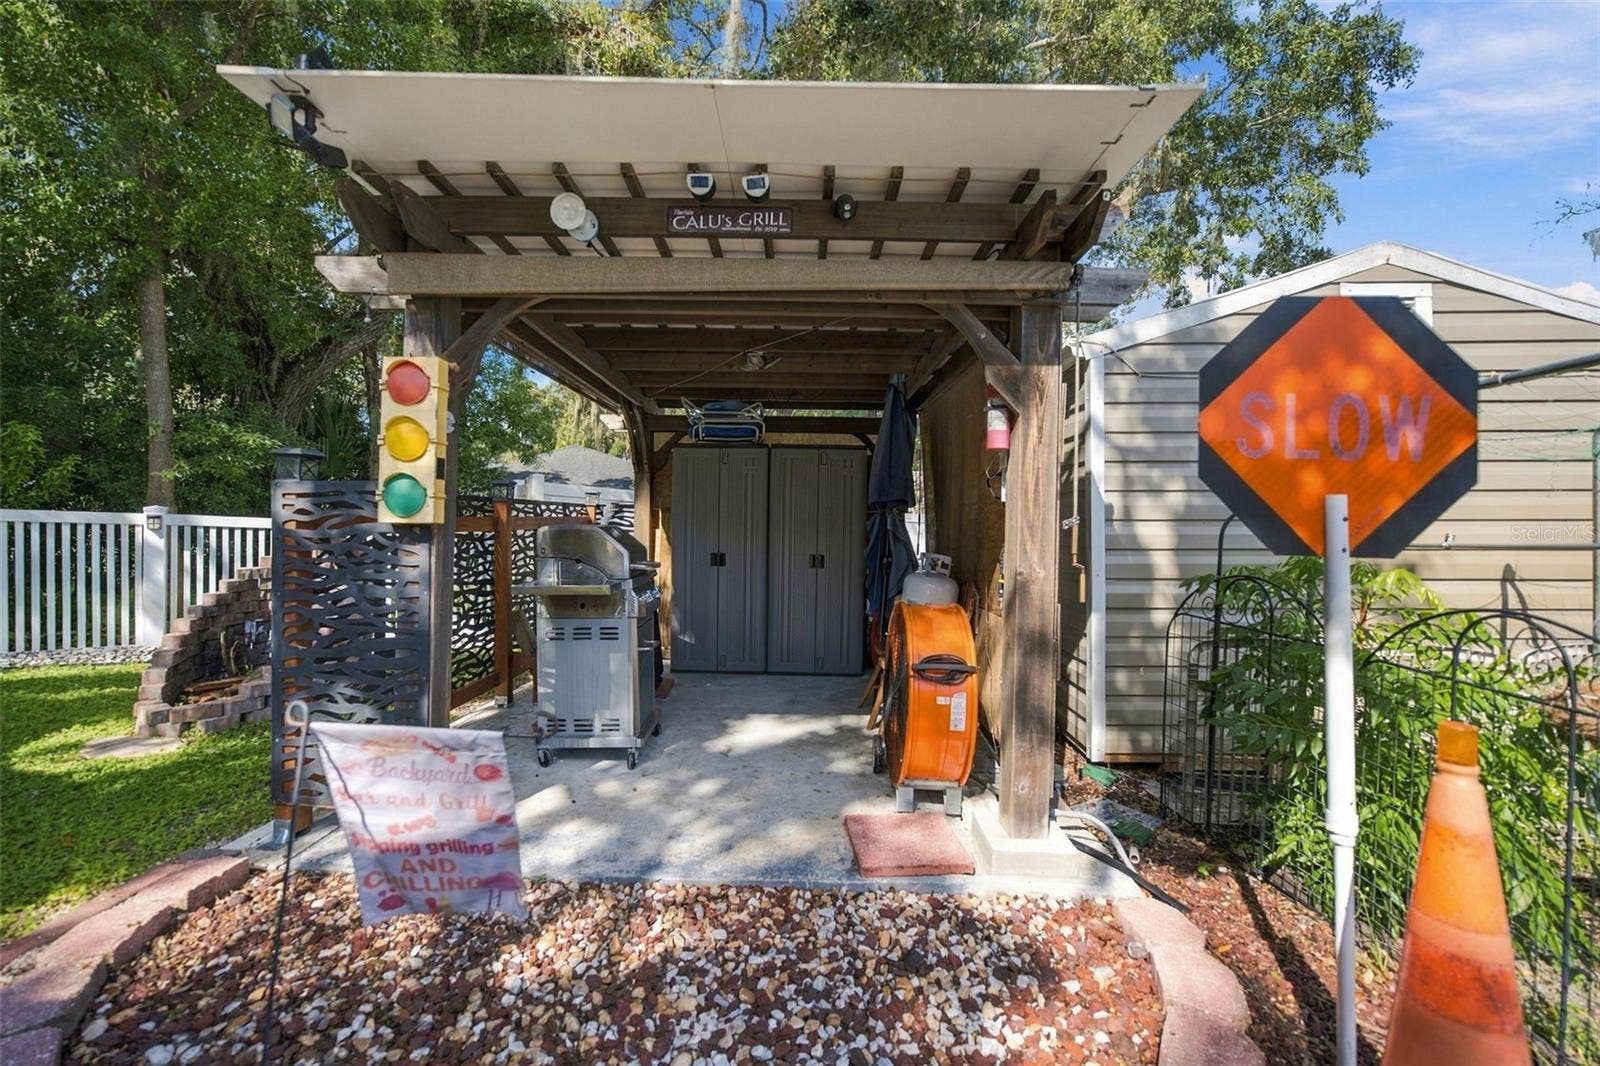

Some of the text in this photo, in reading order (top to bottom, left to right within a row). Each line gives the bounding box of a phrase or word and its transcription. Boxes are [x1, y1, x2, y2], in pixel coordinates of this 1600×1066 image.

[673, 211, 788, 230] CALU's GRILL
[1236, 391, 1431, 463] SLOW
[367, 756, 472, 785] Backyard
[386, 793, 427, 808] and
[426, 838, 494, 855] grilling
[401, 858, 457, 873] AND
